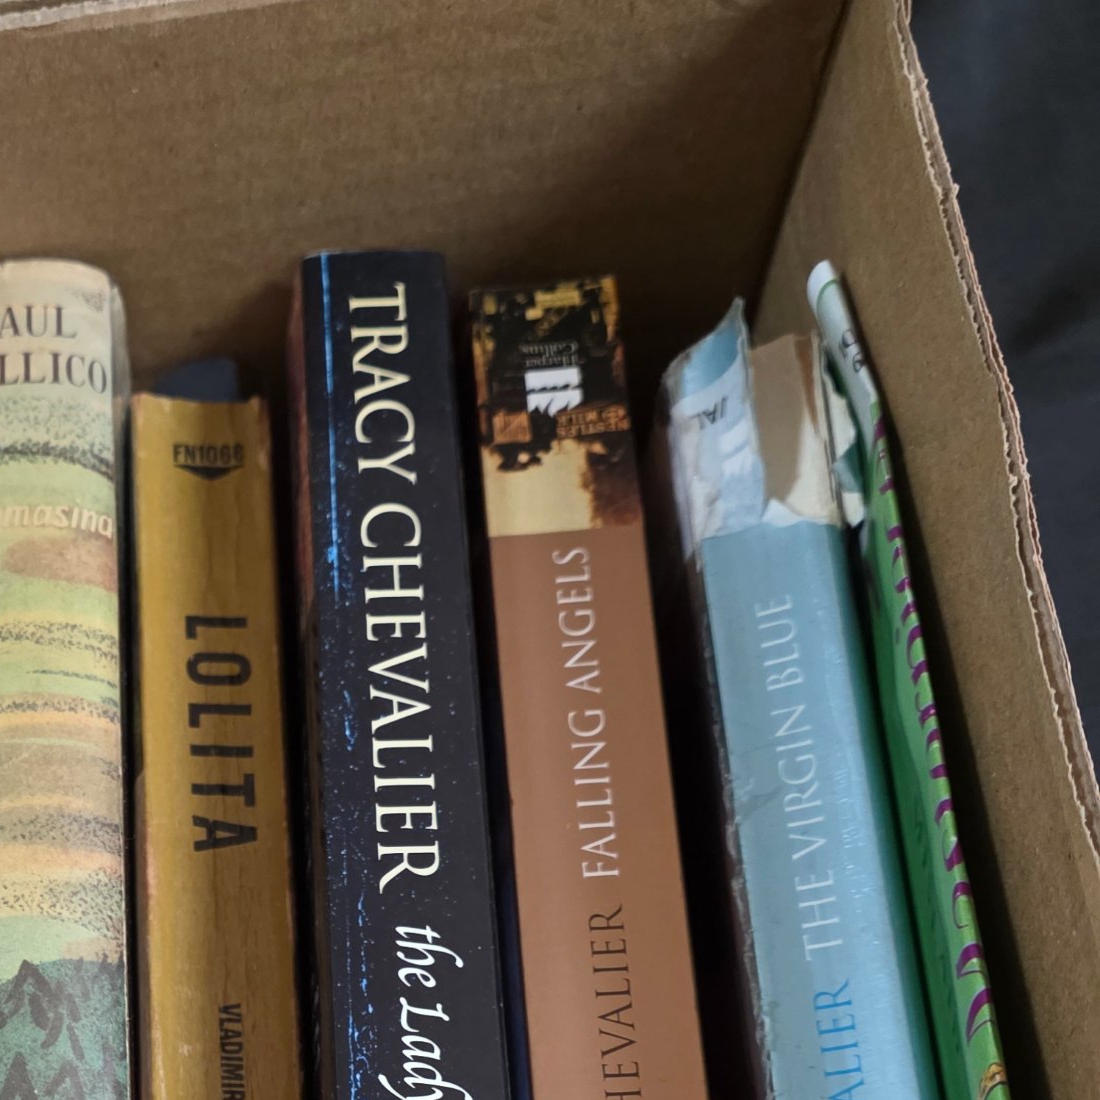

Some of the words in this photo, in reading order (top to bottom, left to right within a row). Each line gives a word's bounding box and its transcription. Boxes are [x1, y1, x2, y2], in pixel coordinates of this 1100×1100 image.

[348, 281, 417, 486] TRACY
[551, 546, 603, 694] ANGELS
[754, 594, 805, 692] BLUE
[185, 615, 258, 852] LOLITA
[359, 503, 440, 895] CHEVALIER
[567, 706, 621, 879] FALLING
[770, 704, 829, 861] VIRGIN
[395, 924, 464, 988] the
[795, 868, 844, 962] THE
